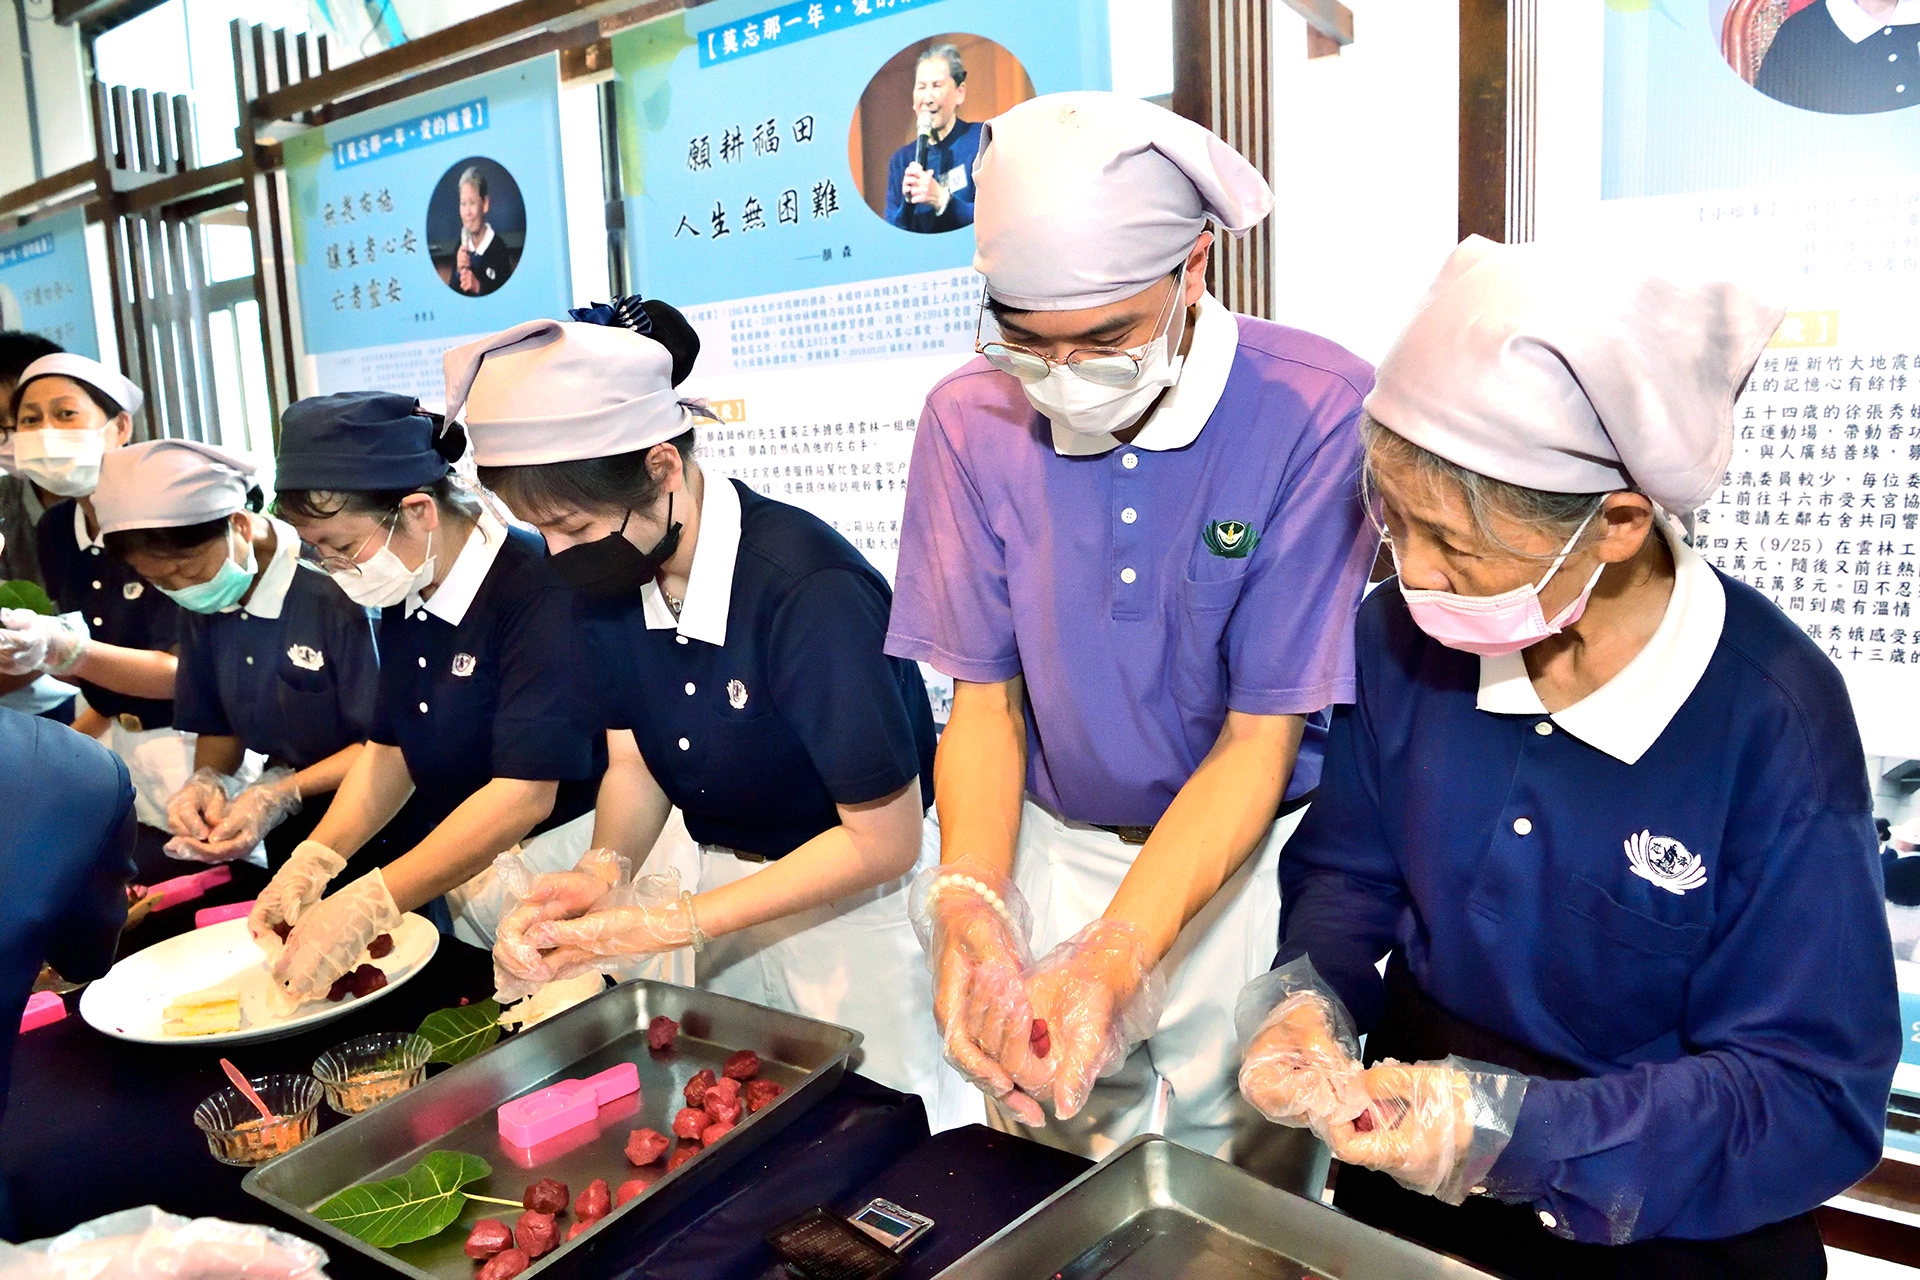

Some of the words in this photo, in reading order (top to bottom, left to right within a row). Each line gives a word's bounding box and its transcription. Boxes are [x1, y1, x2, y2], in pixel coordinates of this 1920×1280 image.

[687, 115, 814, 172] 願耕福田
[674, 179, 840, 239] 人生無困難
[1773, 595, 1911, 617] 人間到處有溫情
